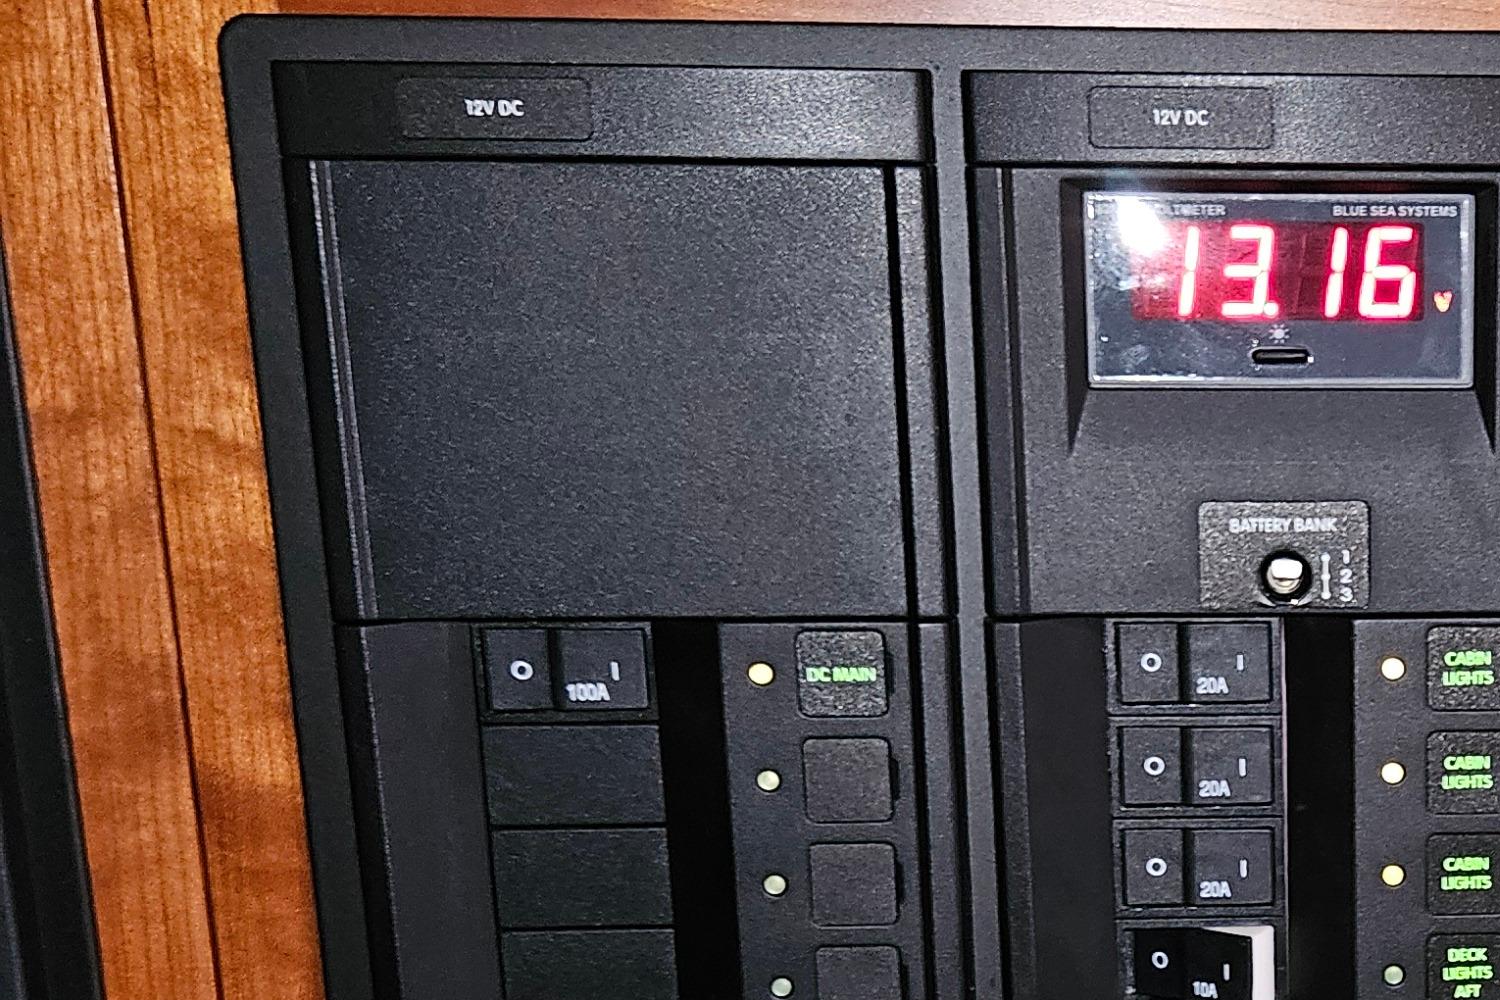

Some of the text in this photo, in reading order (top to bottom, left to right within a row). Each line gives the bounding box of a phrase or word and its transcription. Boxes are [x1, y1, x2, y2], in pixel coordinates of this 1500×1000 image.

[465, 99, 524, 117] 12V DC
[1153, 109, 1208, 126] 12V DC
[1150, 204, 1226, 217] OLTMETER
[1333, 205, 1458, 217] BLUE SEA SYSTEMS
[1229, 518, 1338, 533] BATTERY BANK
[1340, 569, 1352, 584] 2
[1340, 587, 1353, 602] 3
[1444, 649, 1491, 666] CABIN
[806, 667, 876, 682] DC MAIN
[1441, 671, 1494, 689] LIGHTS
[566, 683, 610, 701] 100A
[1197, 677, 1228, 694] 20A
[1444, 756, 1490, 770] CABIN
[1199, 780, 1230, 797] 20A
[1440, 775, 1493, 789] LIGHTS
[1443, 857, 1489, 871] CABIN
[1200, 881, 1231, 897] 20A
[1441, 875, 1492, 890] LIGHTS
[1448, 948, 1487, 962] DECK
[1443, 966, 1493, 980] LIGHTS
[1193, 982, 1217, 998] 10A
[1454, 984, 1481, 998] AFT
